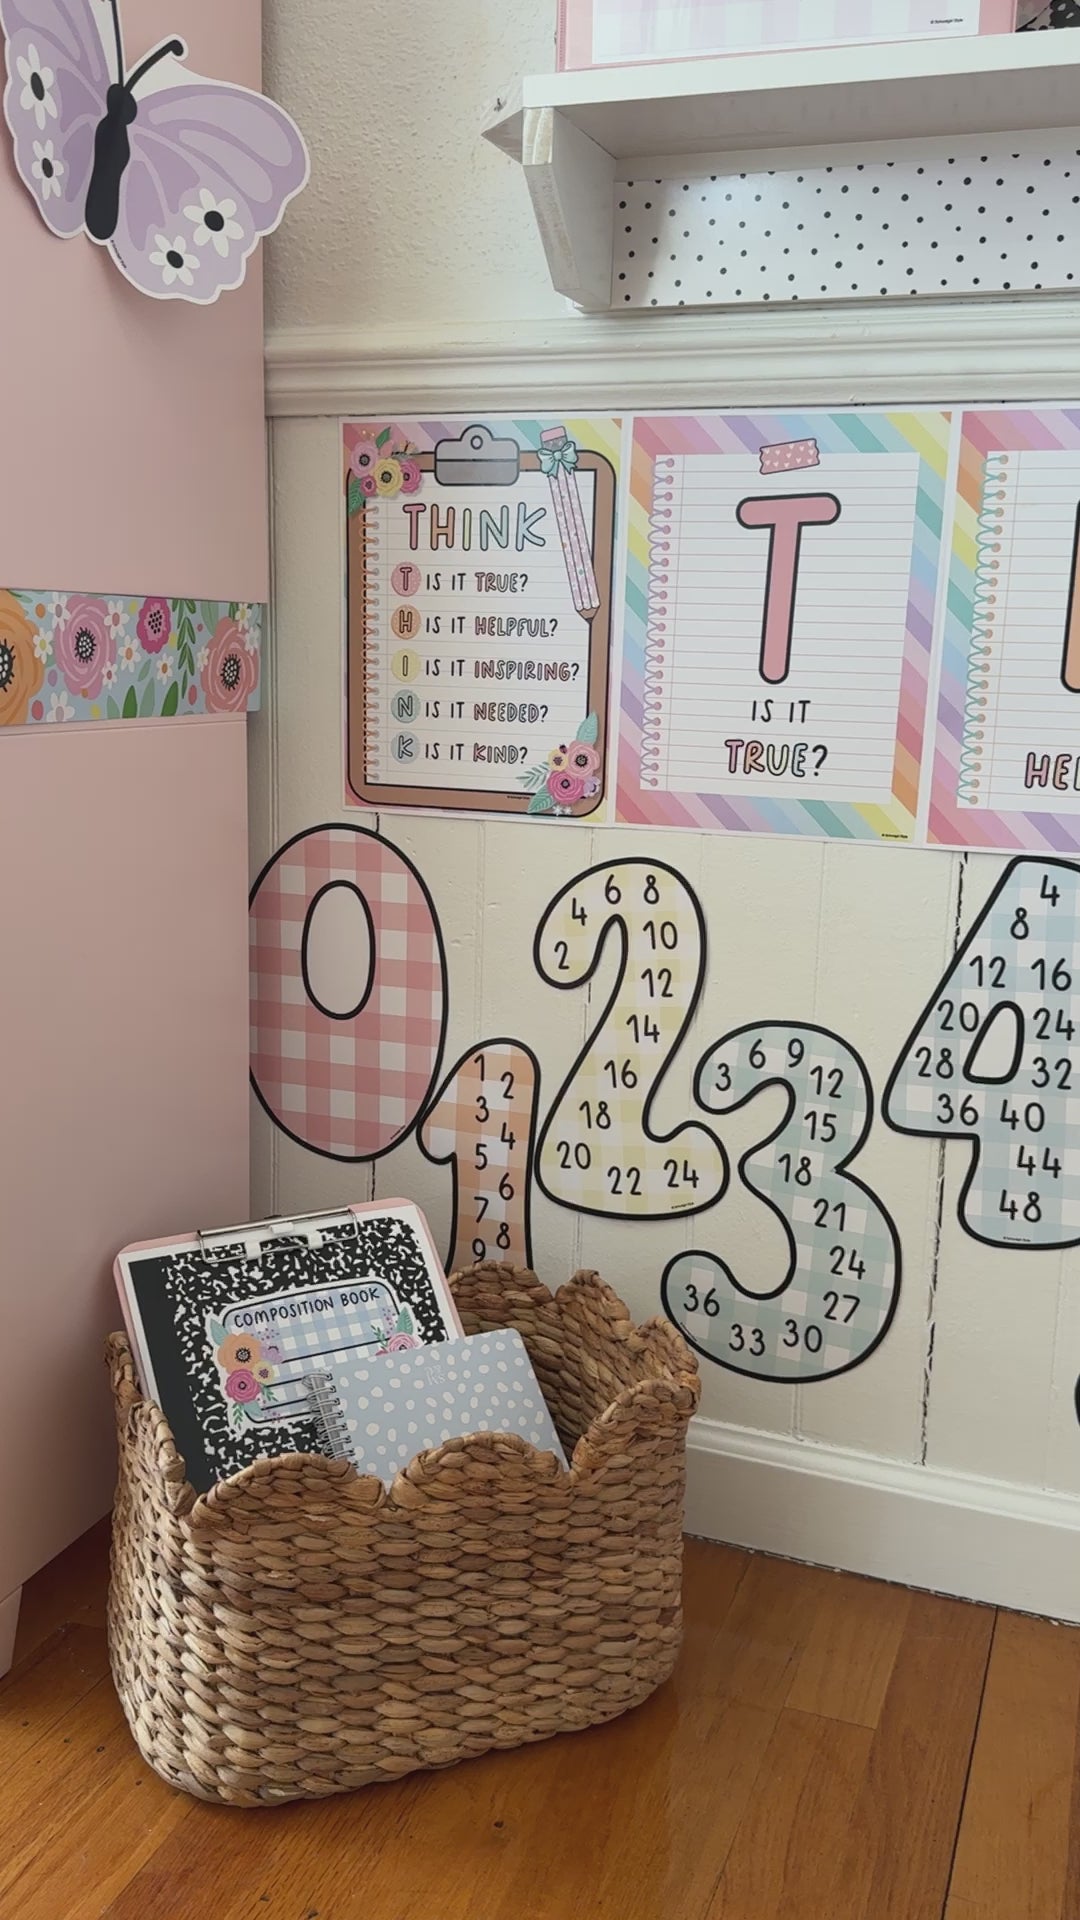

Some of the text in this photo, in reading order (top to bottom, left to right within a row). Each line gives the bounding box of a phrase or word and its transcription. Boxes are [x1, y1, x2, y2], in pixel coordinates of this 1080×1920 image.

[403, 502, 546, 551] THINK
[400, 567, 528, 592] T IS IT TRUE?
[736, 492, 841, 685] T
[399, 610, 558, 637] H IS IT HELPFUL?
[402, 655, 579, 681] I IS IT INSPIRING?
[398, 696, 548, 722] N IS IT NEEDED?
[751, 699, 810, 724] IS IT
[398, 736, 528, 764] K IS IT KIND?
[724, 739, 828, 778] TRUE?
[603, 874, 660, 904] 6 8
[1040, 875, 1060, 906] 4
[571, 897, 587, 926] 4
[1010, 907, 1029, 939] 8
[643, 920, 678, 950] 10
[554, 941, 570, 970] 2
[641, 967, 673, 998] 12
[969, 955, 1072, 990] 12 16
[249, 823, 449, 1163] 0
[626, 1014, 660, 1043] 14
[937, 1001, 1076, 1040] 20 24
[533, 857, 729, 1220] 2
[748, 1037, 804, 1069] 6 9
[881, 855, 1080, 1250] 4
[474, 1054, 485, 1081] 1
[604, 1059, 637, 1088] 16
[715, 1062, 732, 1092] 3
[809, 1065, 844, 1098] 12
[915, 1047, 1072, 1089] 28 32
[501, 1071, 514, 1099] 2
[475, 1096, 489, 1122] 3
[579, 1100, 611, 1129] 18
[937, 1093, 1045, 1132] 36 40
[501, 1123, 515, 1149] 4
[804, 1109, 838, 1143] 15
[416, 1037, 541, 1275] 1
[475, 1143, 488, 1170] 5
[556, 1140, 591, 1170] 20
[777, 1152, 811, 1186] 18
[1017, 1146, 1061, 1178] 44
[499, 1172, 514, 1201] 6
[607, 1166, 642, 1195] 22
[664, 1159, 699, 1189] 24
[474, 1196, 489, 1223] 7
[661, 1019, 901, 1384] 3
[814, 1198, 846, 1232] 21
[1000, 1191, 1041, 1222] 48
[472, 1238, 486, 1263] 9
[496, 1222, 510, 1250] 8
[829, 1245, 866, 1280] 24
[234, 1287, 380, 1328] COMPOSITION BOOK
[683, 1284, 720, 1317] 36
[823, 1291, 860, 1324] 27
[729, 1323, 766, 1356] 33
[783, 1318, 822, 1353] 30
